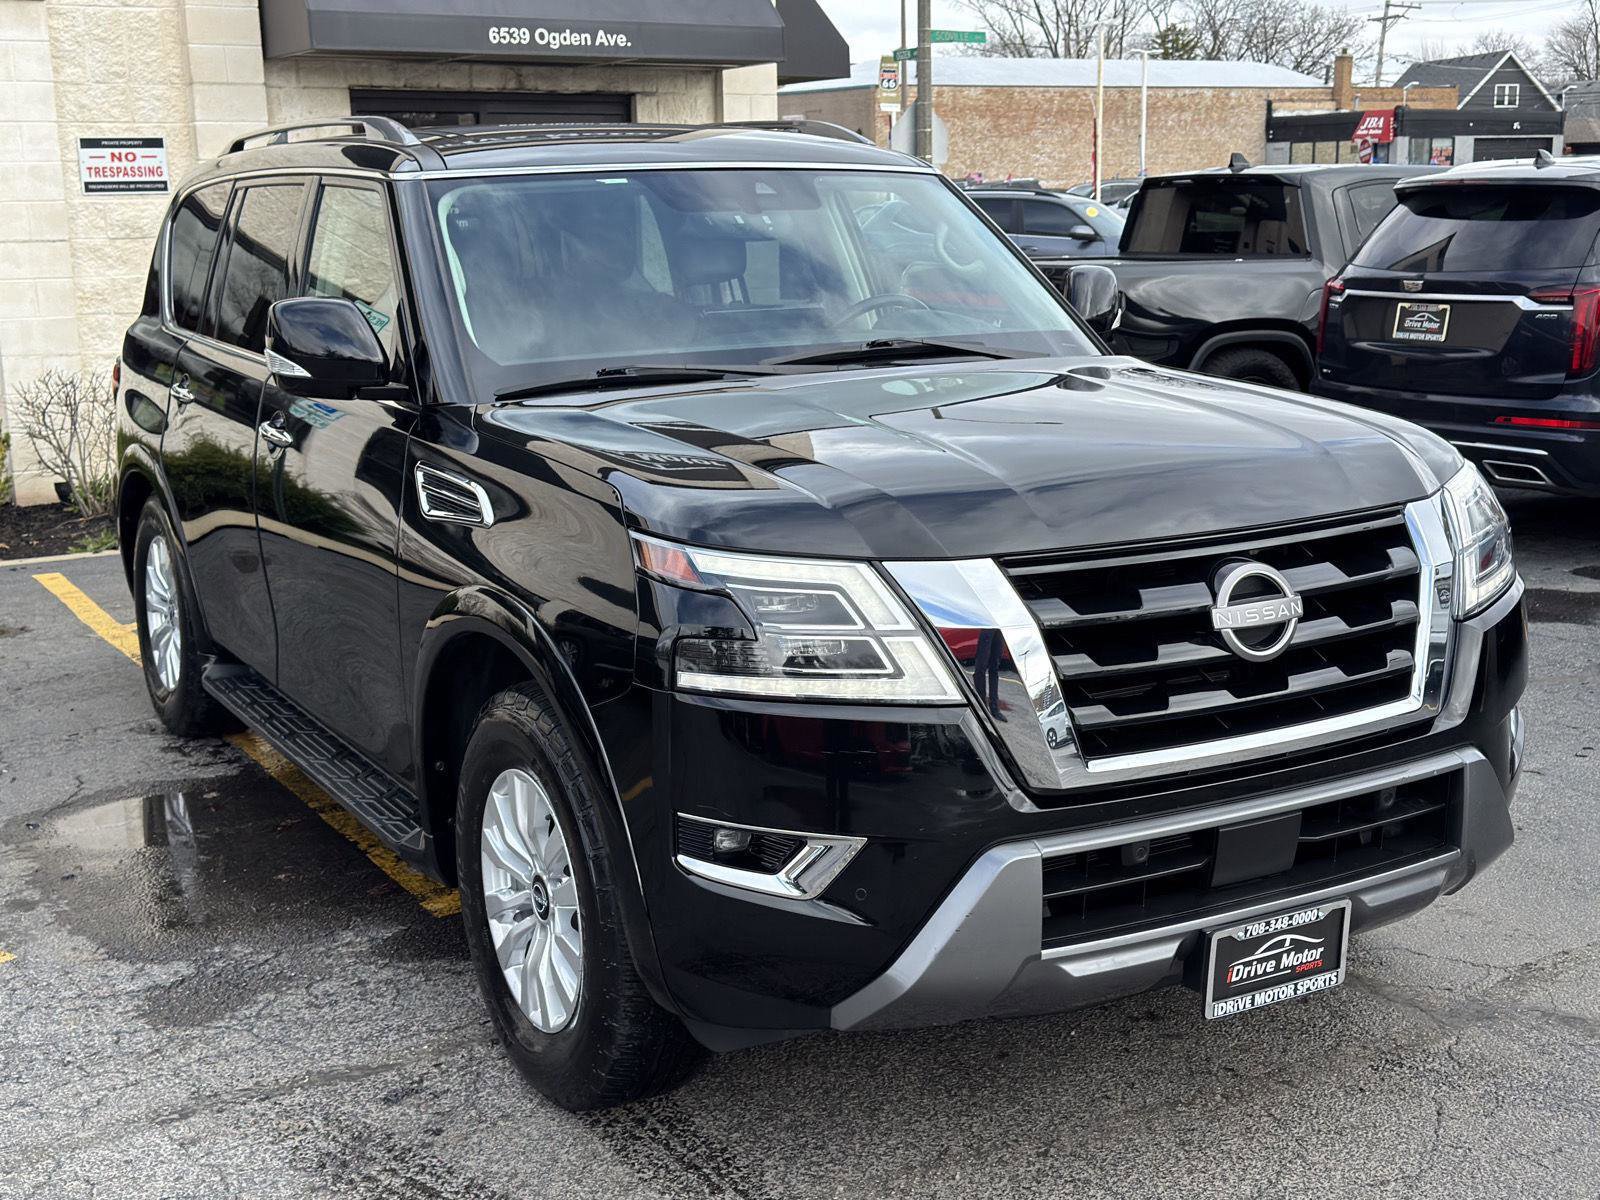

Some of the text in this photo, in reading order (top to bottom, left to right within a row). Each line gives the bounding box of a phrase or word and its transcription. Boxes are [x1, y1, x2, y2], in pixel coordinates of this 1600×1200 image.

[488, 26, 633, 50] 6539 Ogden Ave.
[882, 79, 897, 89] 66
[1359, 116, 1385, 129] JBA
[110, 151, 137, 163] NO
[86, 165, 164, 179] TRESPASSING
[1215, 600, 1303, 626] NISSAN
[1245, 908, 1318, 938] 708-348-0000
[1227, 947, 1324, 982] iDrive Motor
[1295, 959, 1323, 973] SPORTS
[1254, 984, 1295, 1005] MOTOR
[1297, 972, 1338, 995] SPORTS
